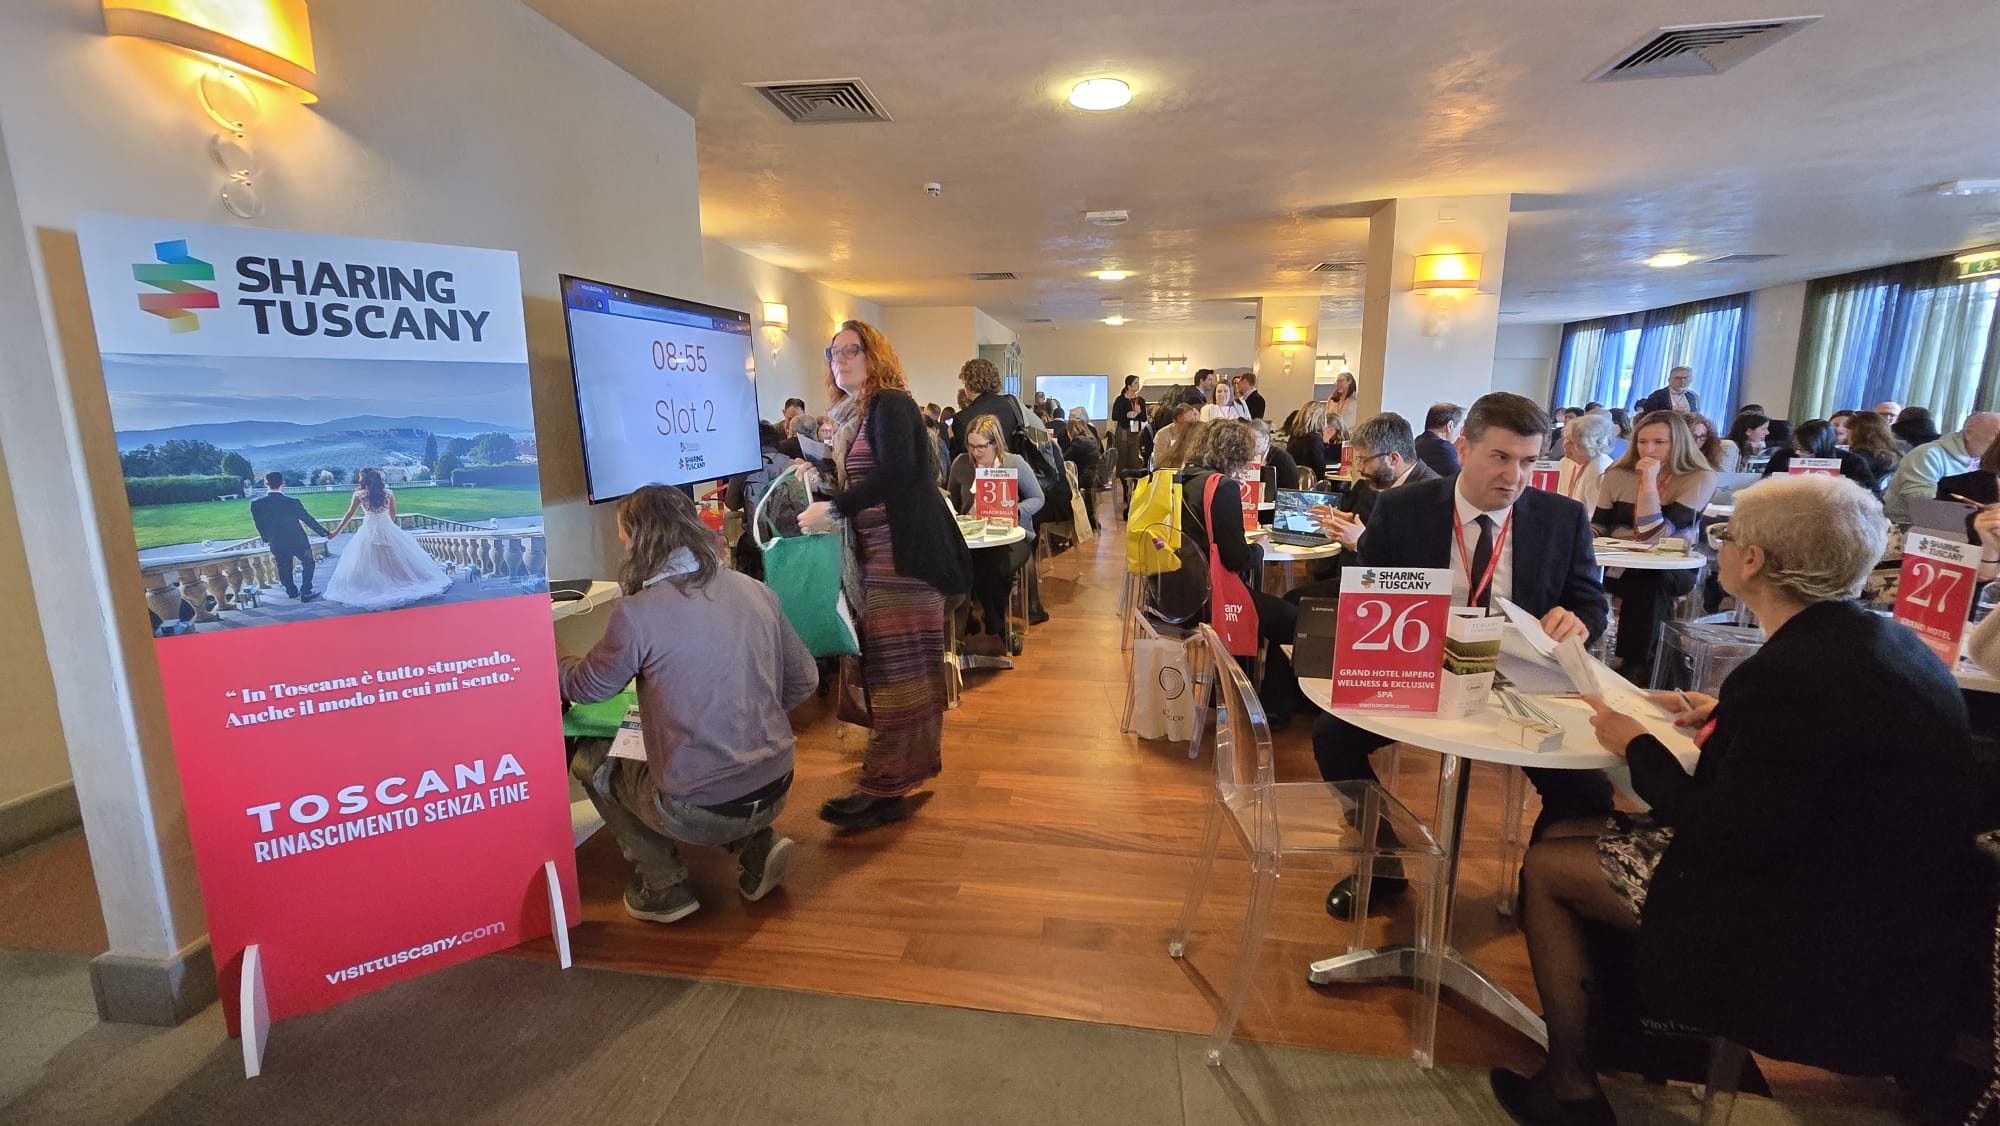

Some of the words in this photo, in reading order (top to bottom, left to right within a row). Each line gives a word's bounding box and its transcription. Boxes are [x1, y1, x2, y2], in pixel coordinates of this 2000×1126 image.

[235, 256, 456, 304] SHARING
[238, 299, 491, 342] TUSCANY
[652, 340, 707, 372] 08:55
[655, 398, 698, 435] Slot
[704, 399, 717, 431] 2
[983, 481, 1015, 506] 31
[1929, 548, 1965, 562] TUSCANY
[1930, 540, 1960, 552] SHARING
[1378, 571, 1425, 580] SHARING
[1378, 580, 1432, 590] TUSCANY
[1906, 562, 1963, 613] 27
[1351, 600, 1430, 653] 26
[1926, 625, 1952, 640] HOTEL
[269, 675, 358, 699] Toscana
[361, 670, 373, 685] è
[376, 665, 424, 683] tutto
[427, 651, 516, 675] stupendo.
[1337, 679, 1381, 688] WELLNESS
[1391, 680, 1436, 689] EXCLUSIVE
[1339, 668, 1370, 677] GRAND
[1372, 669, 1400, 678] HOTEL
[1402, 670, 1435, 679] IMPERO
[225, 705, 296, 729] Anche
[298, 699, 315, 716] il
[318, 691, 376, 713] modo
[378, 688, 399, 703] in
[402, 681, 431, 699] cui
[434, 676, 459, 693] mi
[1377, 690, 1393, 698] SPA
[246, 753, 526, 833] TOSCANA
[254, 806, 419, 864] RINASCIMENTO
[424, 792, 486, 823] SENZA
[488, 780, 530, 808] FINE
